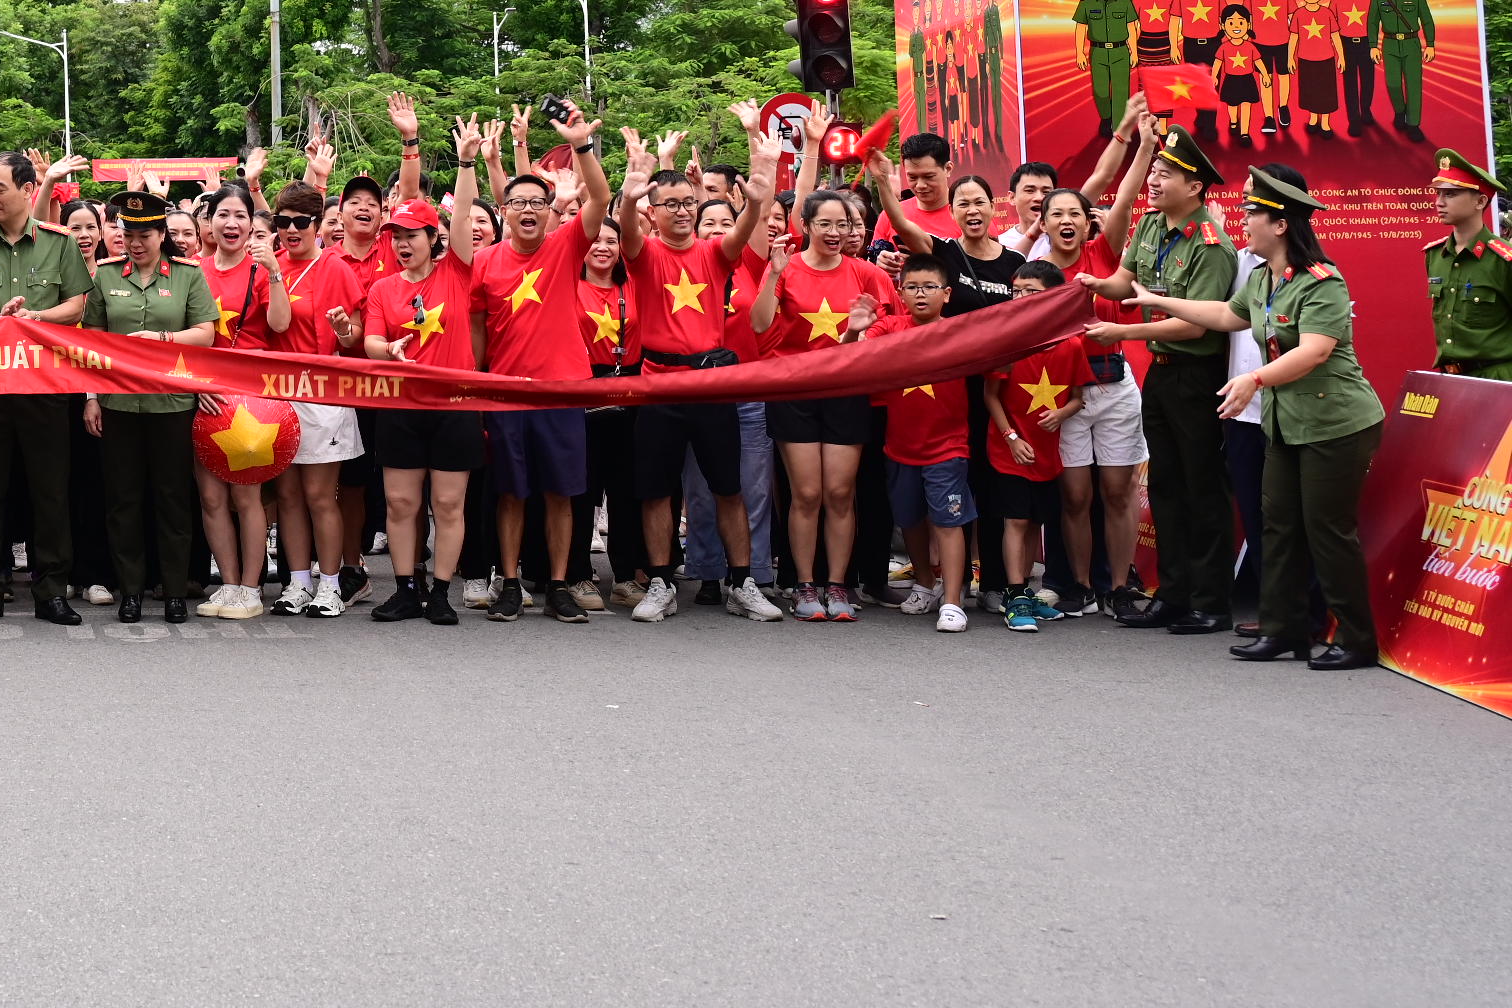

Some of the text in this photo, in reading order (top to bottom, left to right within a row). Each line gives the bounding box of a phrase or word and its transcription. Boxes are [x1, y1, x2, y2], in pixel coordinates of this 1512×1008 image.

[829, 132, 855, 156] 21
[1221, 191, 1238, 199] DÂN
[1322, 188, 1345, 196] CÔNG
[1374, 186, 1397, 196] CHỨC
[1399, 186, 1423, 195] ĐỒNG
[1343, 203, 1360, 211] KHU
[1361, 202, 1384, 210] TRÊN
[1386, 201, 1407, 210] TOÀN
[1410, 201, 1434, 210] QUỐC
[1323, 217, 1347, 226] QUỐC
[1349, 216, 1379, 225] KHÁNH
[1329, 232, 1372, 240] (19/8/1945
[1380, 231, 1422, 239] 19/8/2025)
[261, 370, 328, 398] XUẤT
[1401, 392, 1439, 414] Nhân Dân
[1420, 500, 1512, 566] VIỆT NA
[1422, 547, 1500, 591] tiến bước
